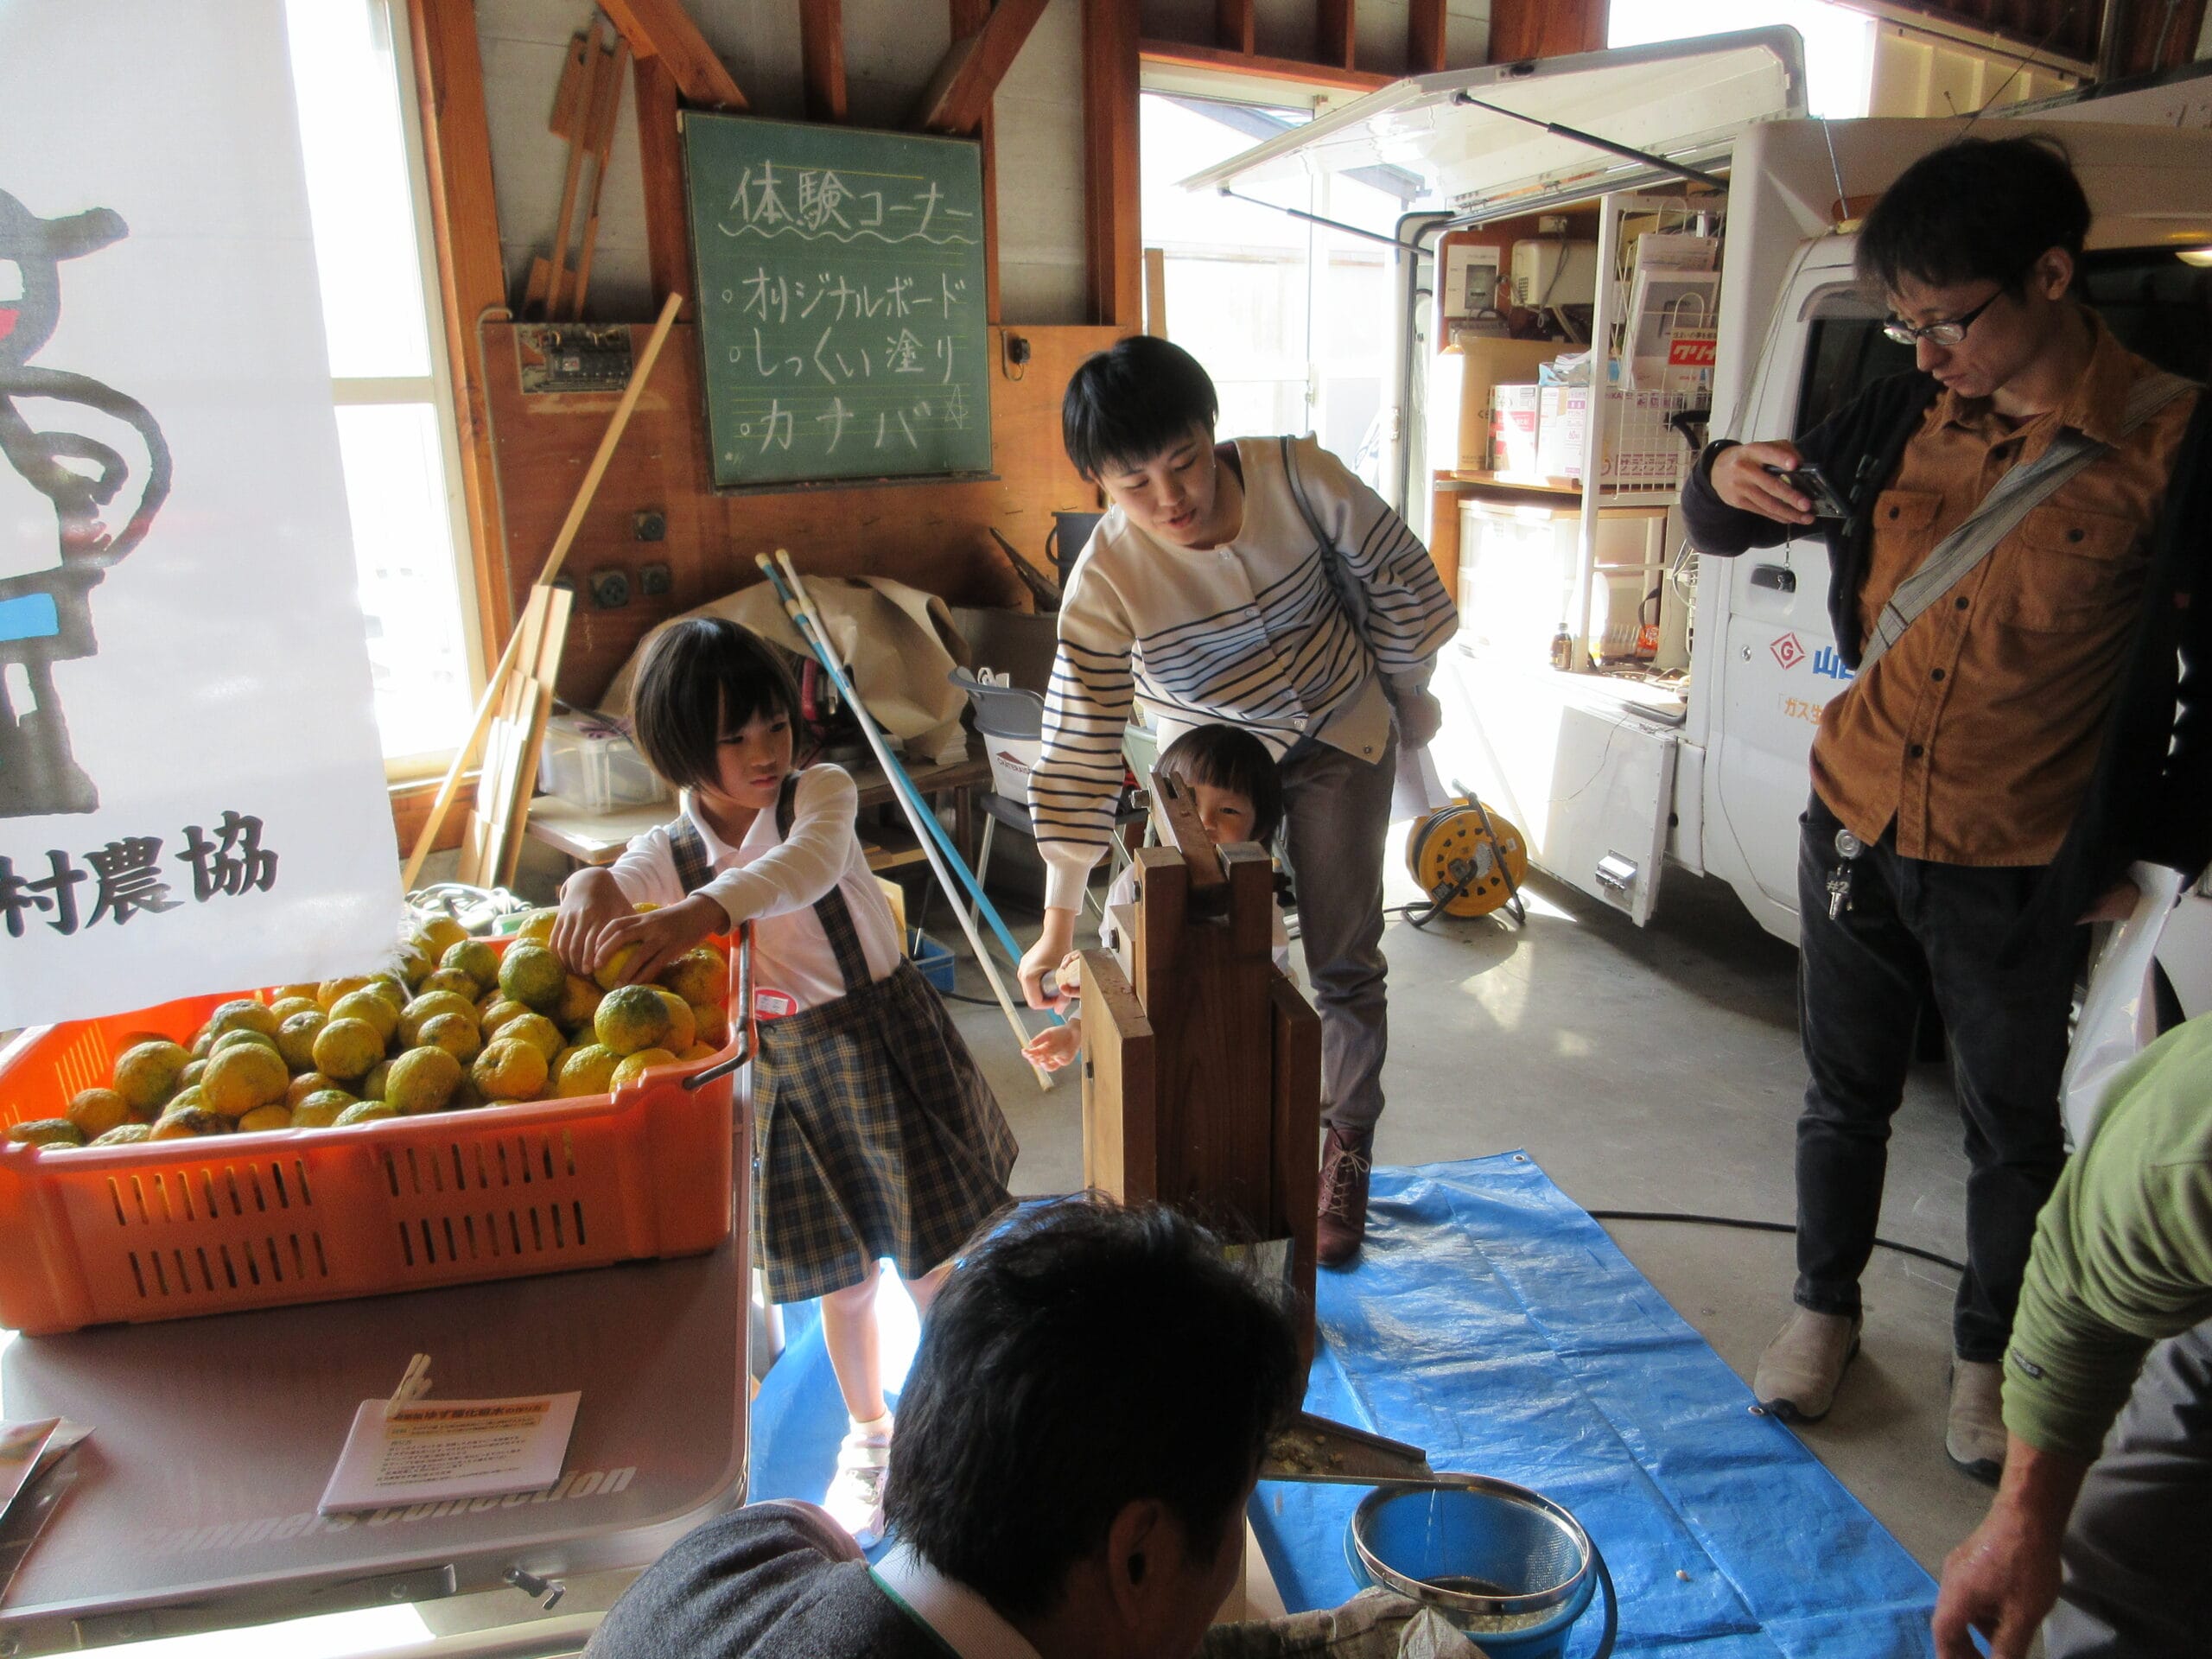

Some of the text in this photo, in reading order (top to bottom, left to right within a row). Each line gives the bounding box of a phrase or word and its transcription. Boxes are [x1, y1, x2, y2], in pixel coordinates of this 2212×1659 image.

[730, 159, 973, 233] 体験コーナー
[743, 268, 966, 322] オリジナルボード
[753, 326, 952, 385] しっくい塗り
[0, 810, 279, 938] 村農協
